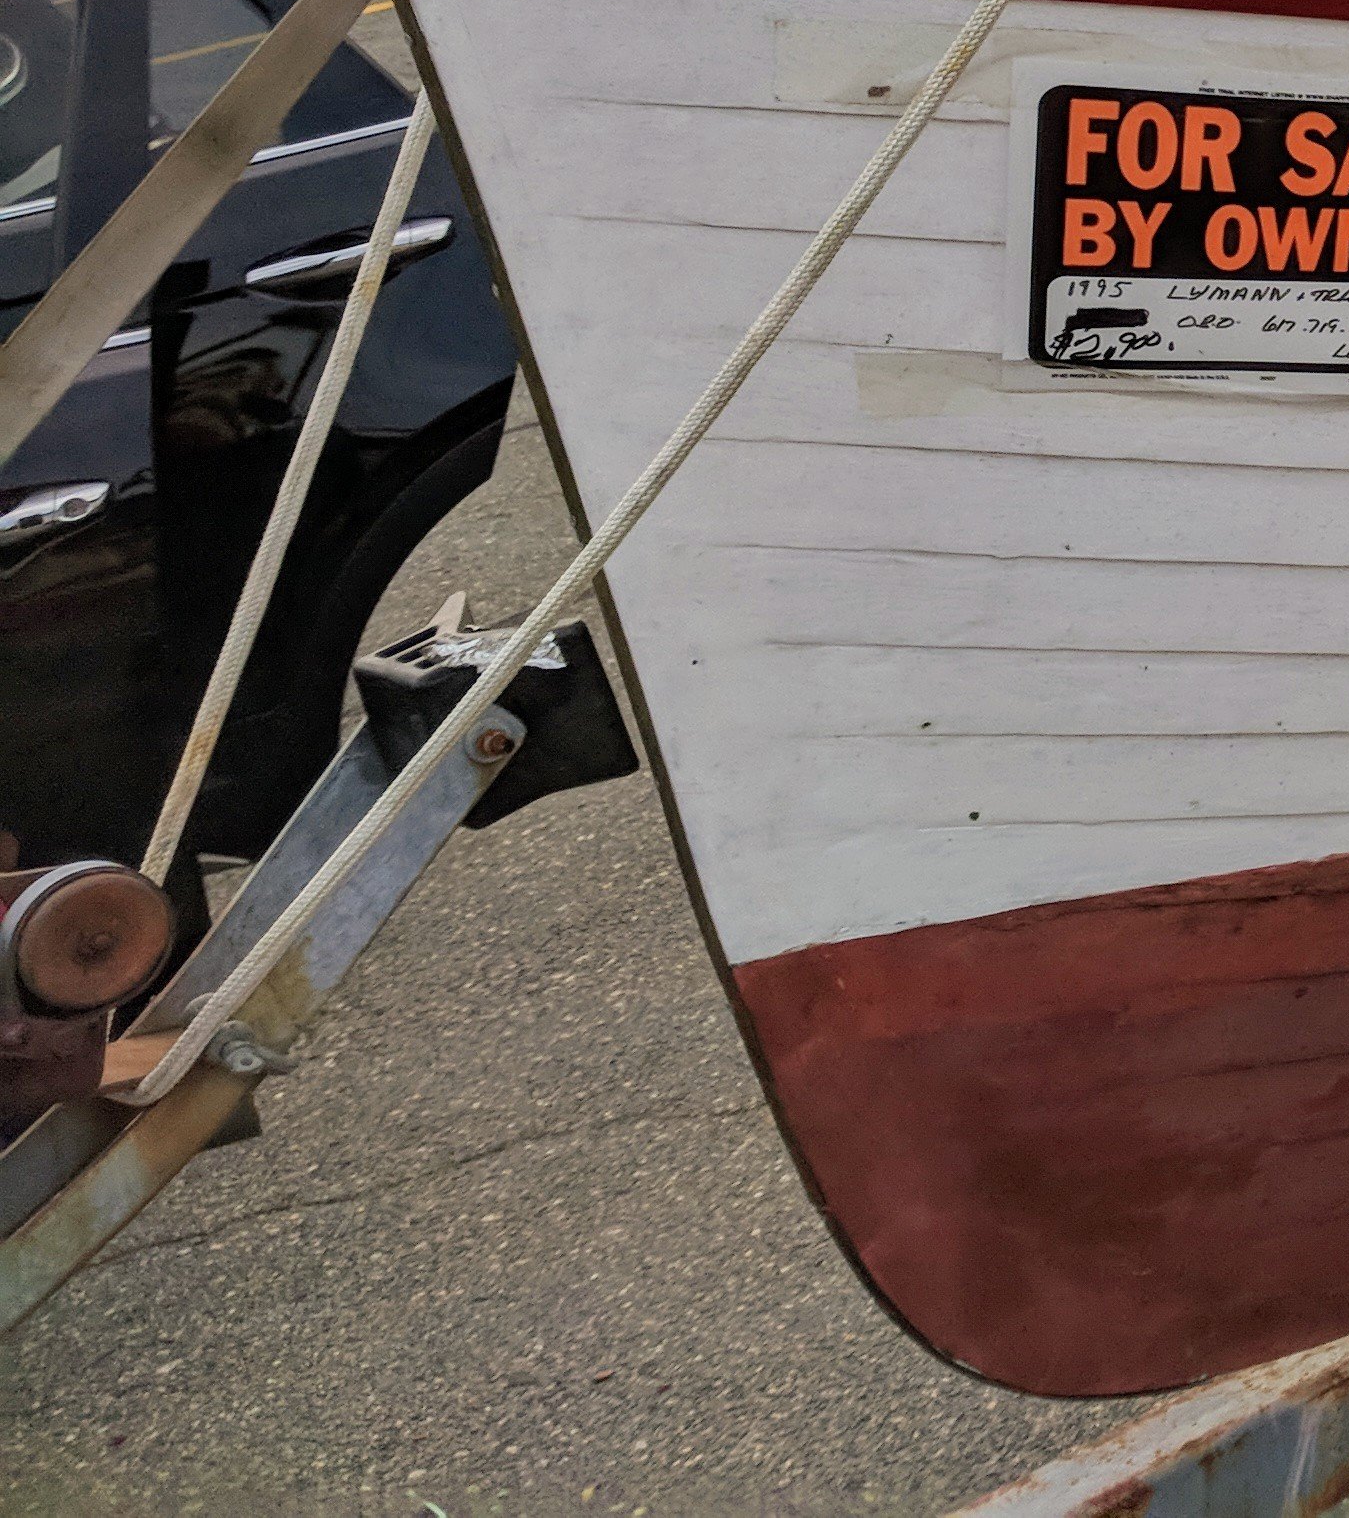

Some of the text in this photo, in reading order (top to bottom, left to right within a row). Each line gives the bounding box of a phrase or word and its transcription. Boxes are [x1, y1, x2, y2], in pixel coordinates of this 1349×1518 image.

[1066, 98, 1242, 193] FOR
[1062, 198, 1173, 268] BY
[1068, 280, 1132, 297] 1995
[1166, 285, 1291, 301] LYMANN
